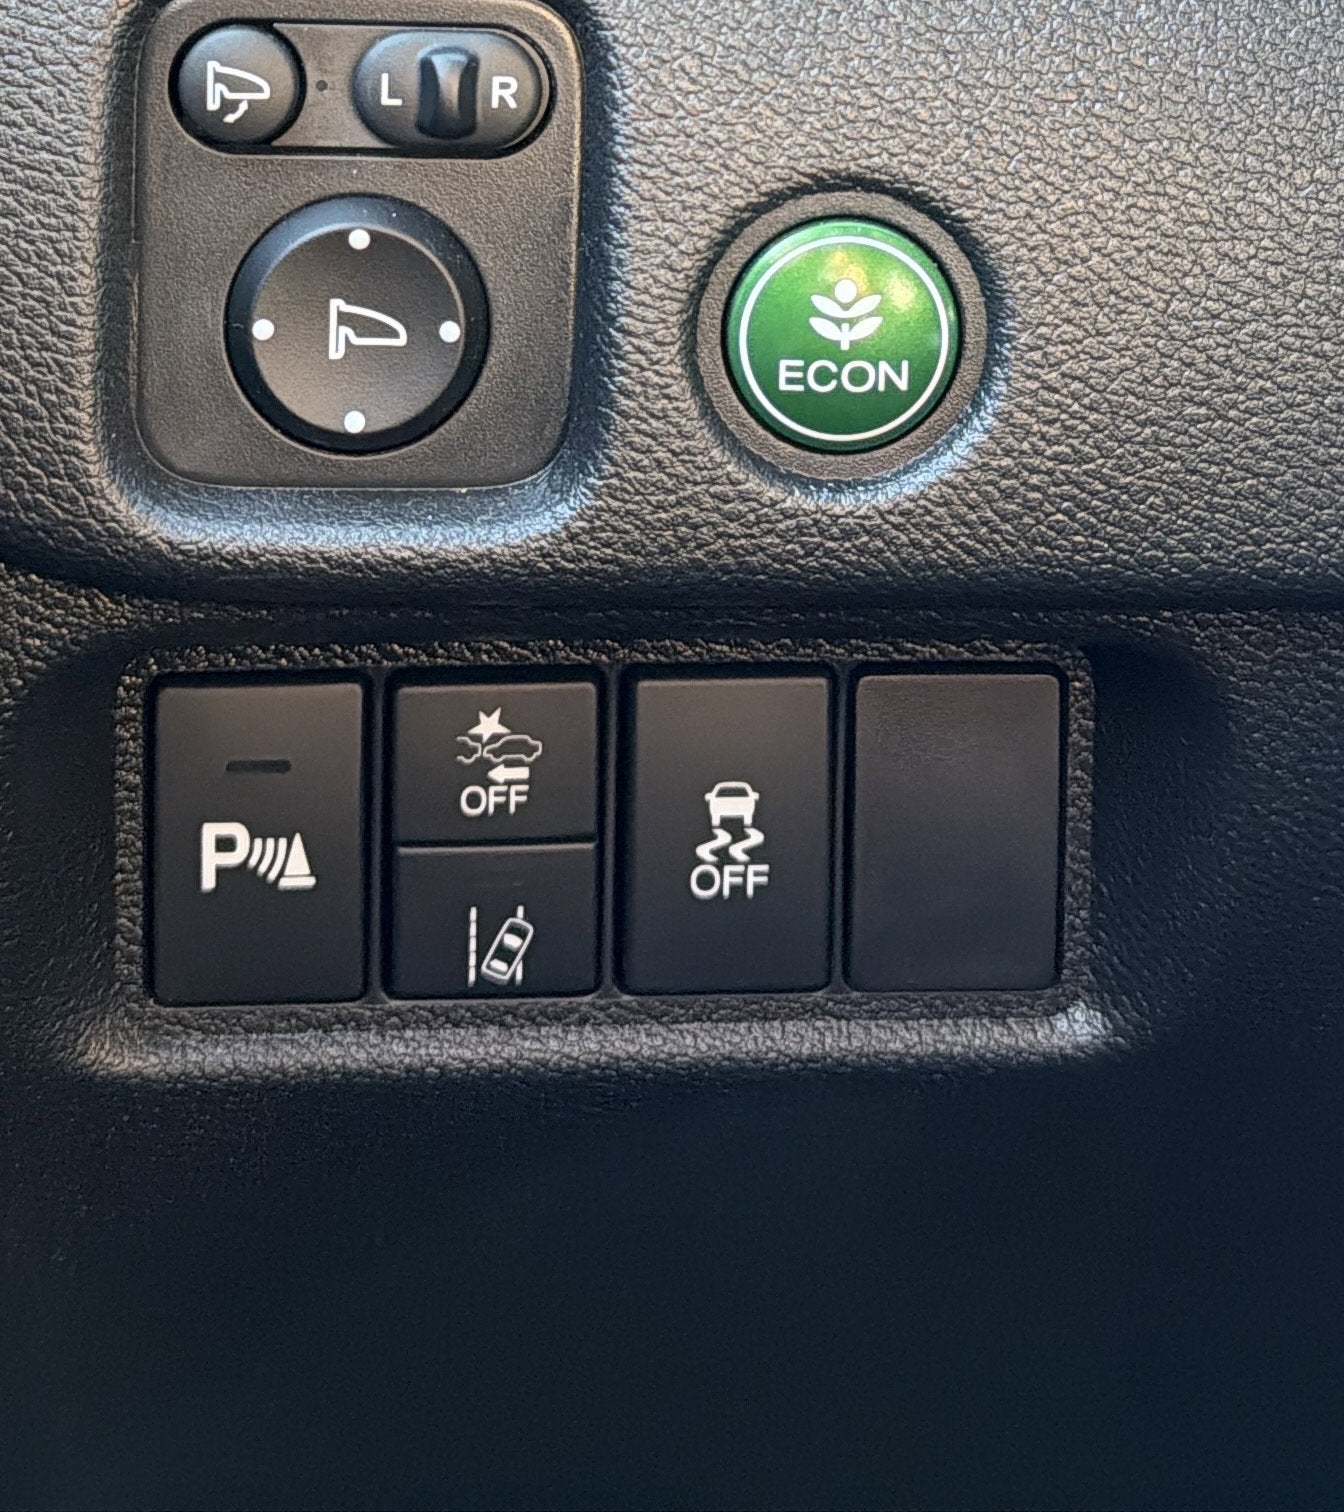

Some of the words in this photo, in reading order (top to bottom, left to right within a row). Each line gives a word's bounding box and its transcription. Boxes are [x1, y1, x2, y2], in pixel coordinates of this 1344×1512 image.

[380, 72, 403, 106] L
[491, 75, 518, 109] R
[778, 359, 909, 393] ECON
[460, 784, 530, 817] OFF
[690, 863, 770, 900] OFF
